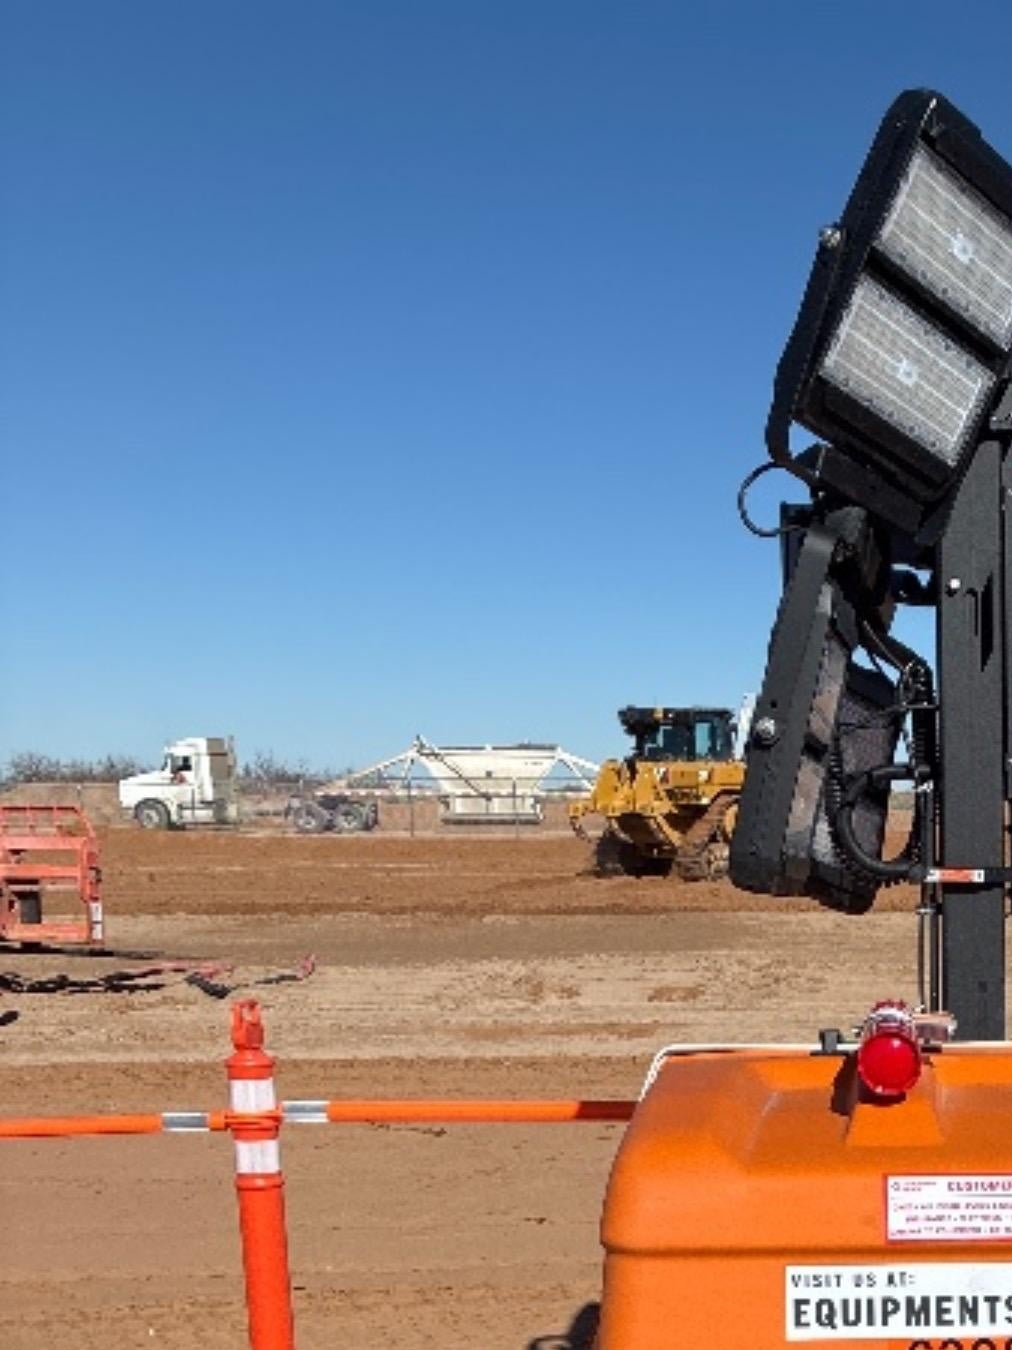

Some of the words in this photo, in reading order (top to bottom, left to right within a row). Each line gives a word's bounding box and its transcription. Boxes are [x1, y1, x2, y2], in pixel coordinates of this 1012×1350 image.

[791, 1274, 843, 1289] VISIT
[853, 1273, 877, 1288] US
[886, 1272, 915, 1288] AT:
